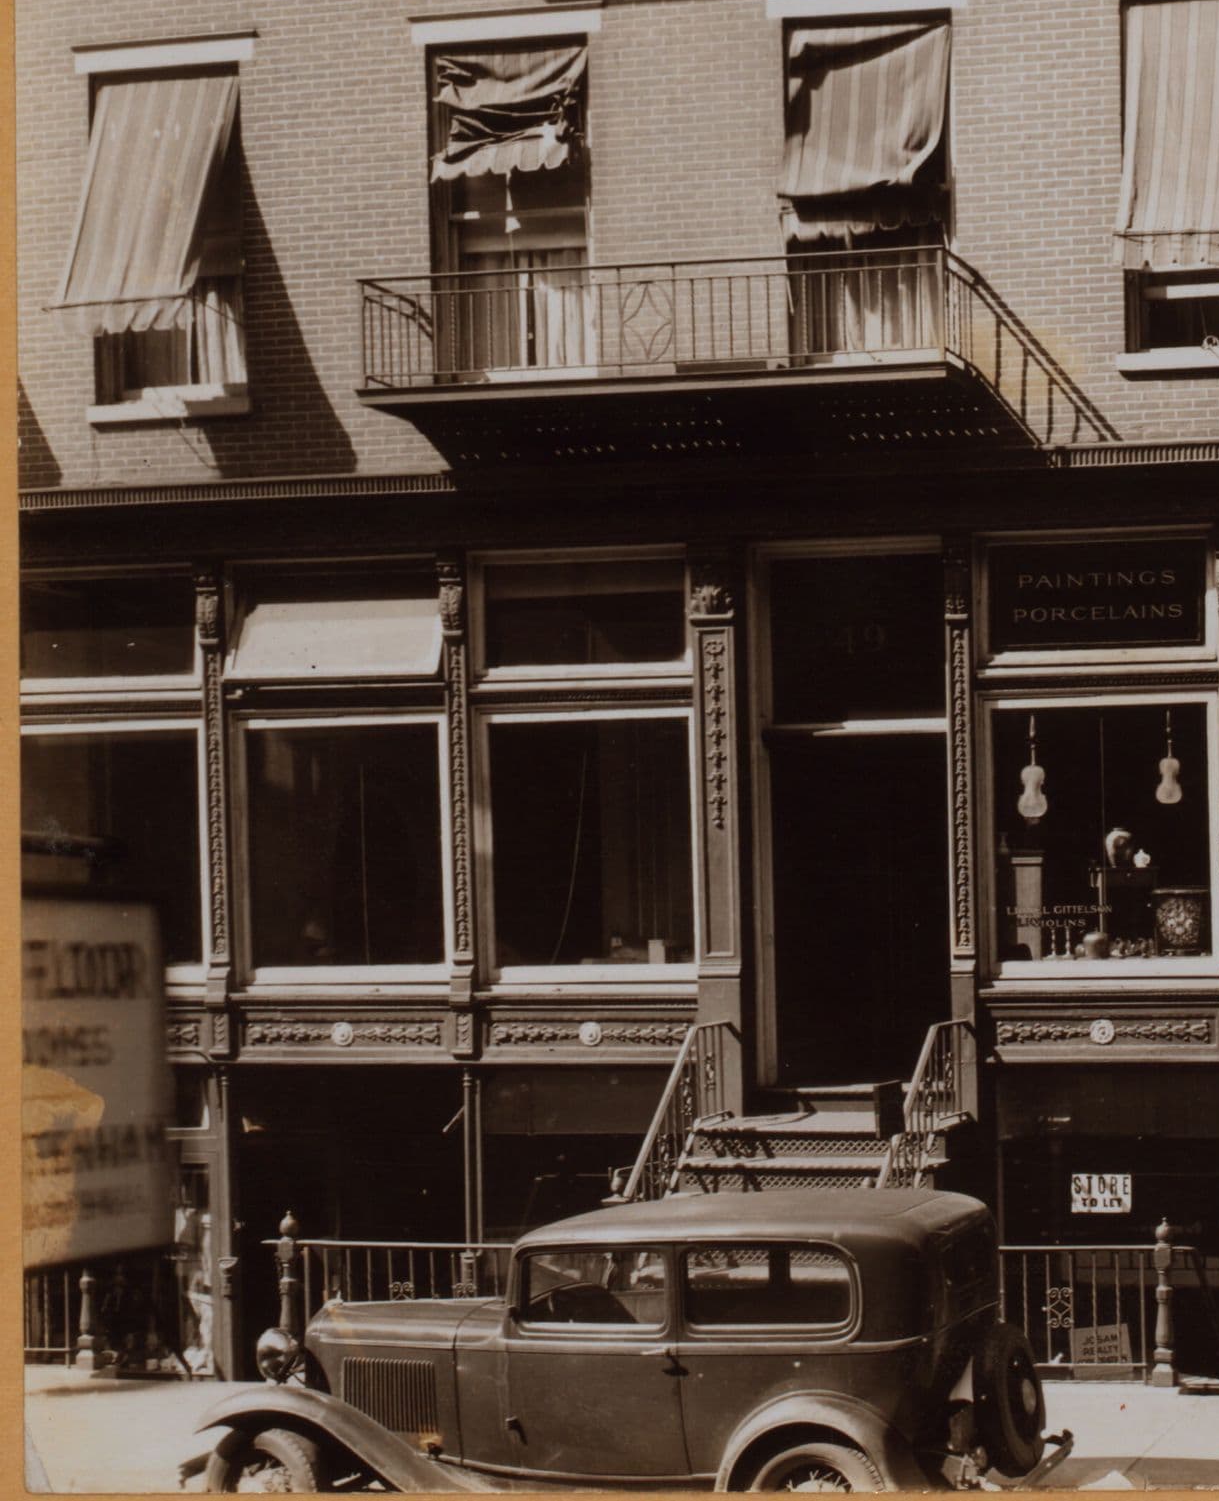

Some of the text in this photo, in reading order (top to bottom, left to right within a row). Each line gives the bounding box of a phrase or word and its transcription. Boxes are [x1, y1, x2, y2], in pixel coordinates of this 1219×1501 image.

[1017, 569, 1177, 589] PAINTINGS
[1012, 603, 1185, 624] PORCELAINS
[1073, 1175, 1130, 1196] STORE
[1081, 1197, 1123, 1208] TO LET
